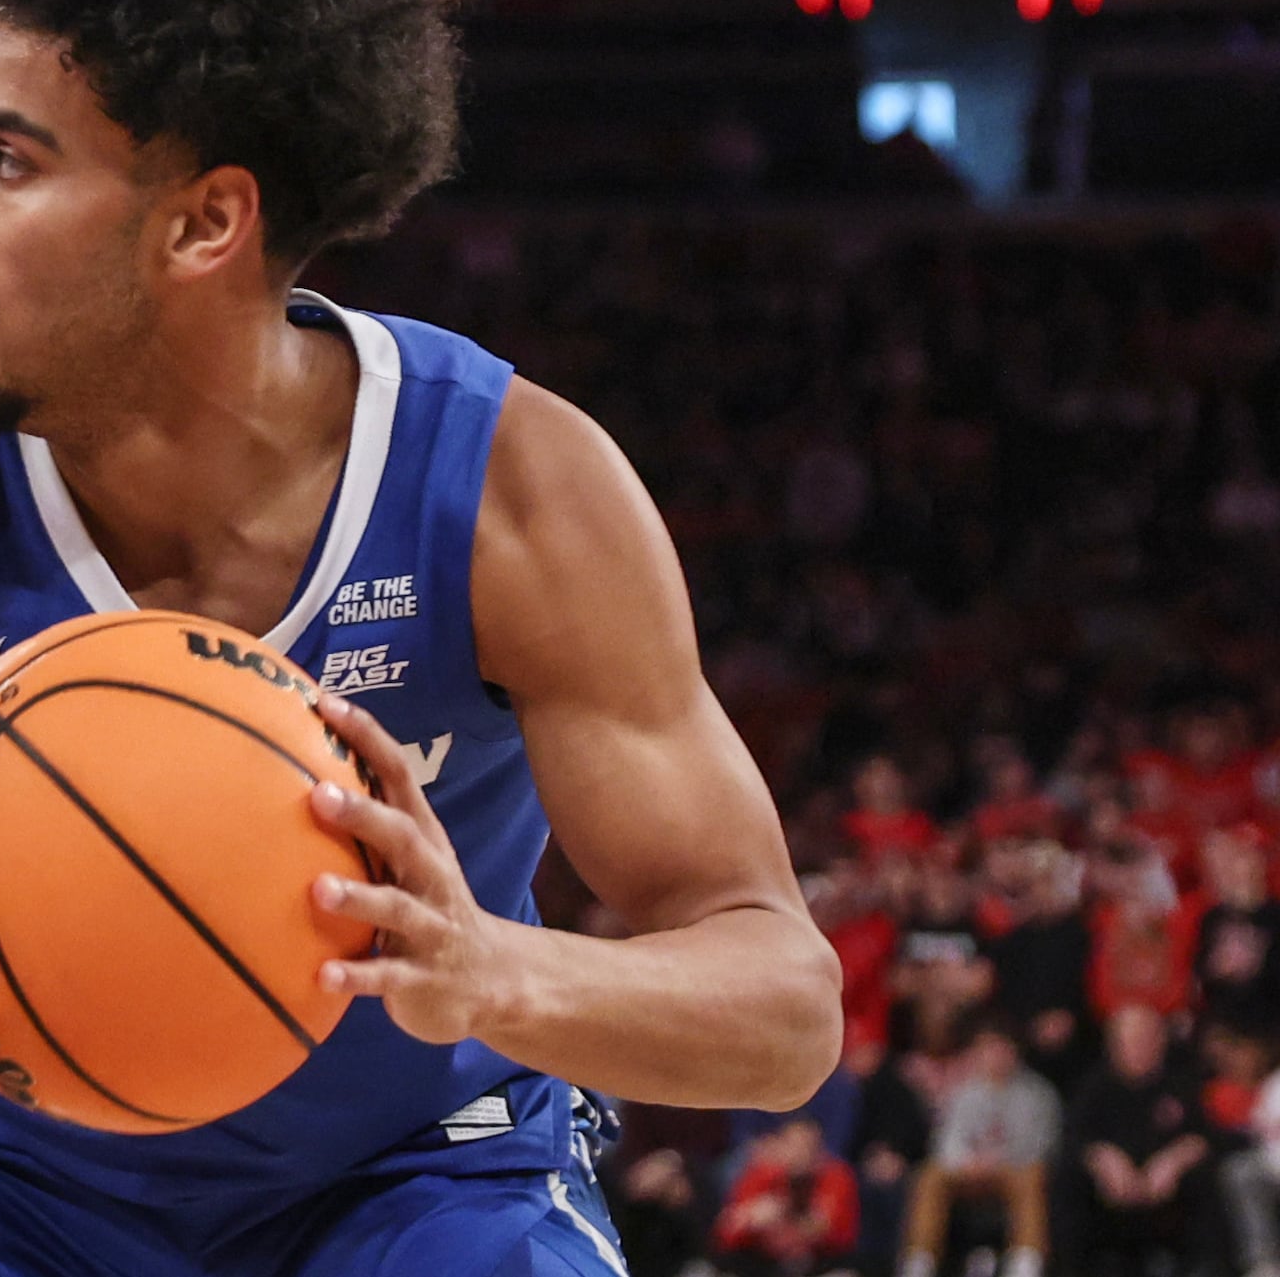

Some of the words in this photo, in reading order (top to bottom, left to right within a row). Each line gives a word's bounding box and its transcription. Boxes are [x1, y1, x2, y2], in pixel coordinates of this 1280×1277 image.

[336, 581, 368, 604] BE
[372, 574, 415, 599] THE
[328, 594, 419, 626] CHANGE
[323, 643, 390, 675] BIG
[319, 660, 410, 692] EAST
